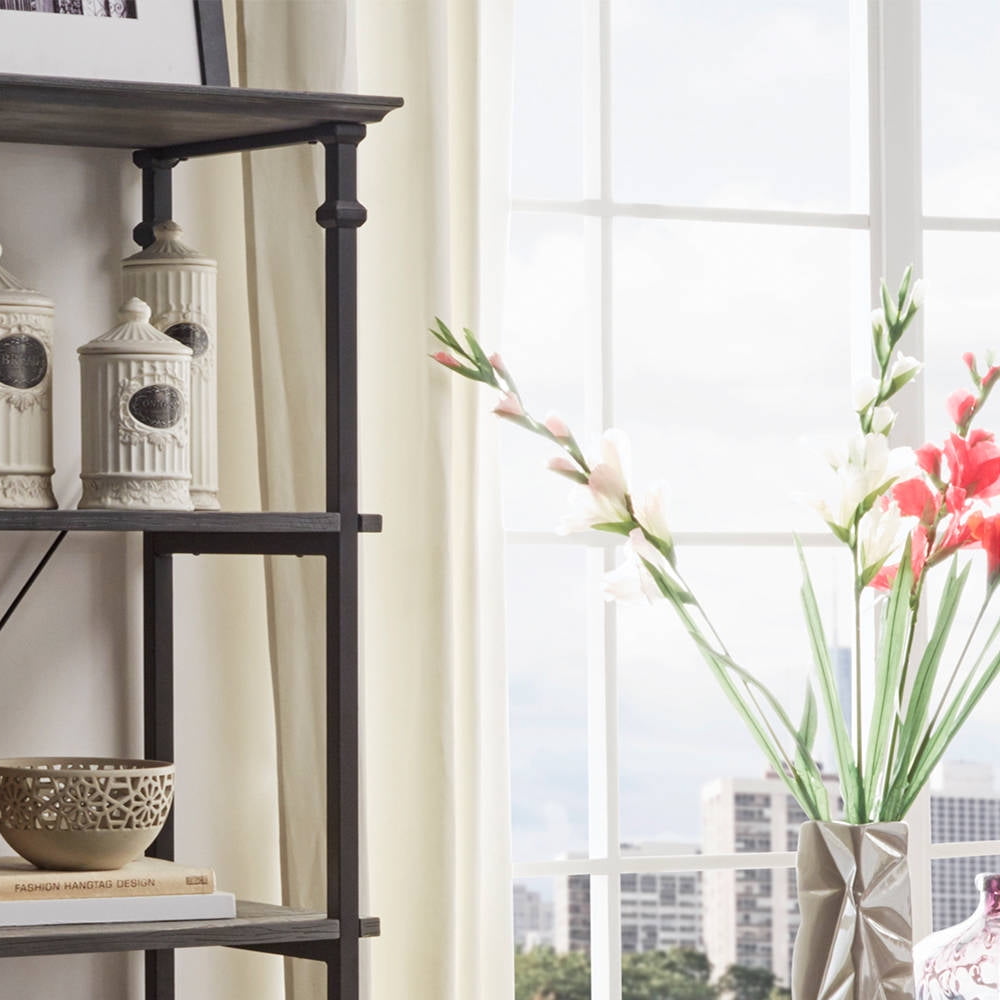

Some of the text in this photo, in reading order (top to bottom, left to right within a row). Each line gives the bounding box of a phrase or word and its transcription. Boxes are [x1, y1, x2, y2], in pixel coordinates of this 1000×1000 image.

[14, 878, 156, 893] FASHION HANGTAG DESIGN
